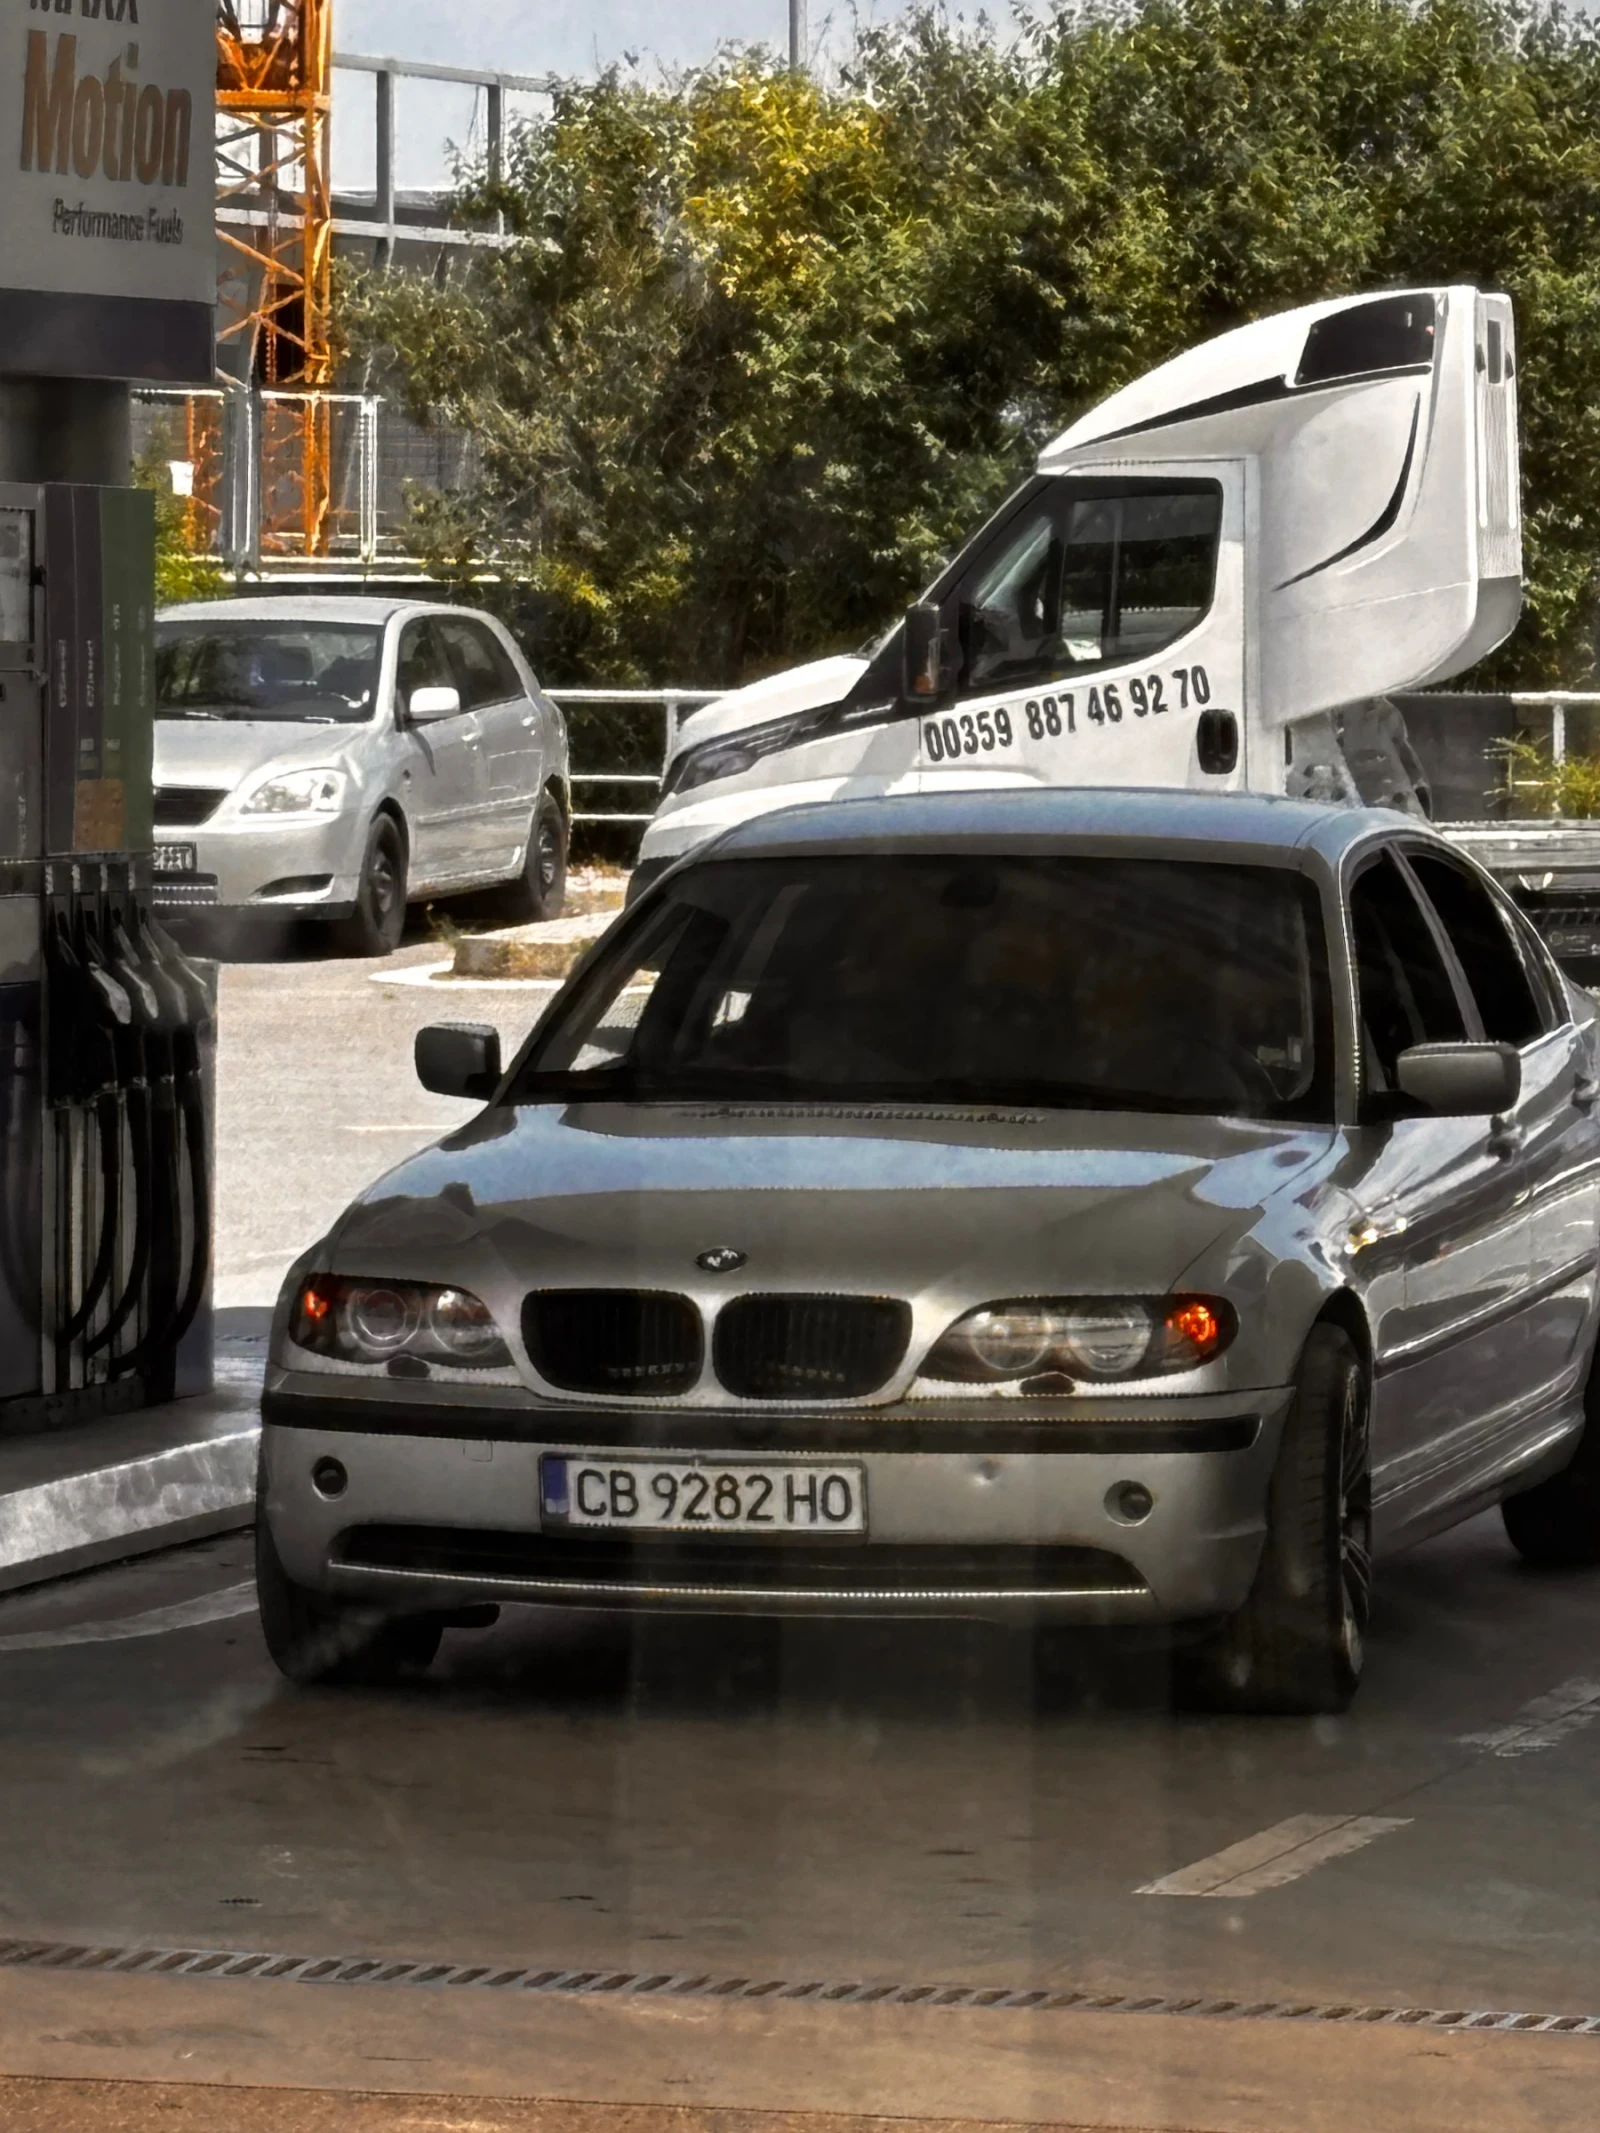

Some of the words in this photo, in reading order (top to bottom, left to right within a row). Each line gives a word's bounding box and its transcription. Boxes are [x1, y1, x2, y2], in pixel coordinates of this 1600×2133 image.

[20, 29, 192, 187] Motion
[52, 197, 145, 242] Performance
[147, 206, 184, 245] Fuels
[924, 708, 1012, 762] 00359
[1025, 693, 1076, 740] 887
[1087, 685, 1122, 726] 46
[1130, 674, 1168, 717] 92
[1173, 665, 1210, 708] 70
[576, 1468, 639, 1518] CB
[651, 1472, 774, 1521] 9282
